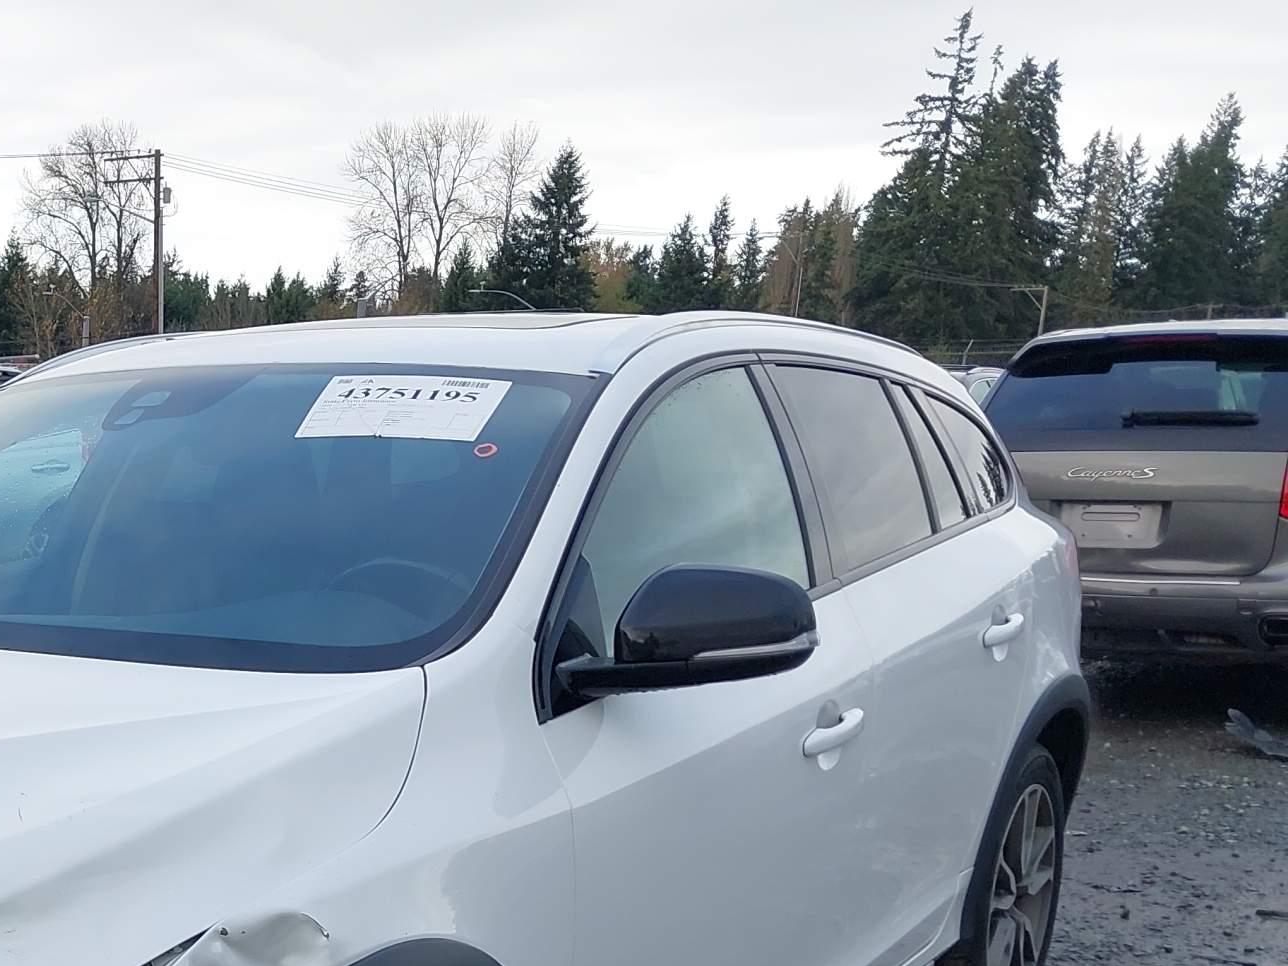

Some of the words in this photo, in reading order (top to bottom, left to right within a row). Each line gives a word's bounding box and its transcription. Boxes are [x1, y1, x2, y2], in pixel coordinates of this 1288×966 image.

[337, 387, 481, 403] 43751195
[1067, 466, 1141, 481] Cayenne
[1133, 466, 1159, 479] S
